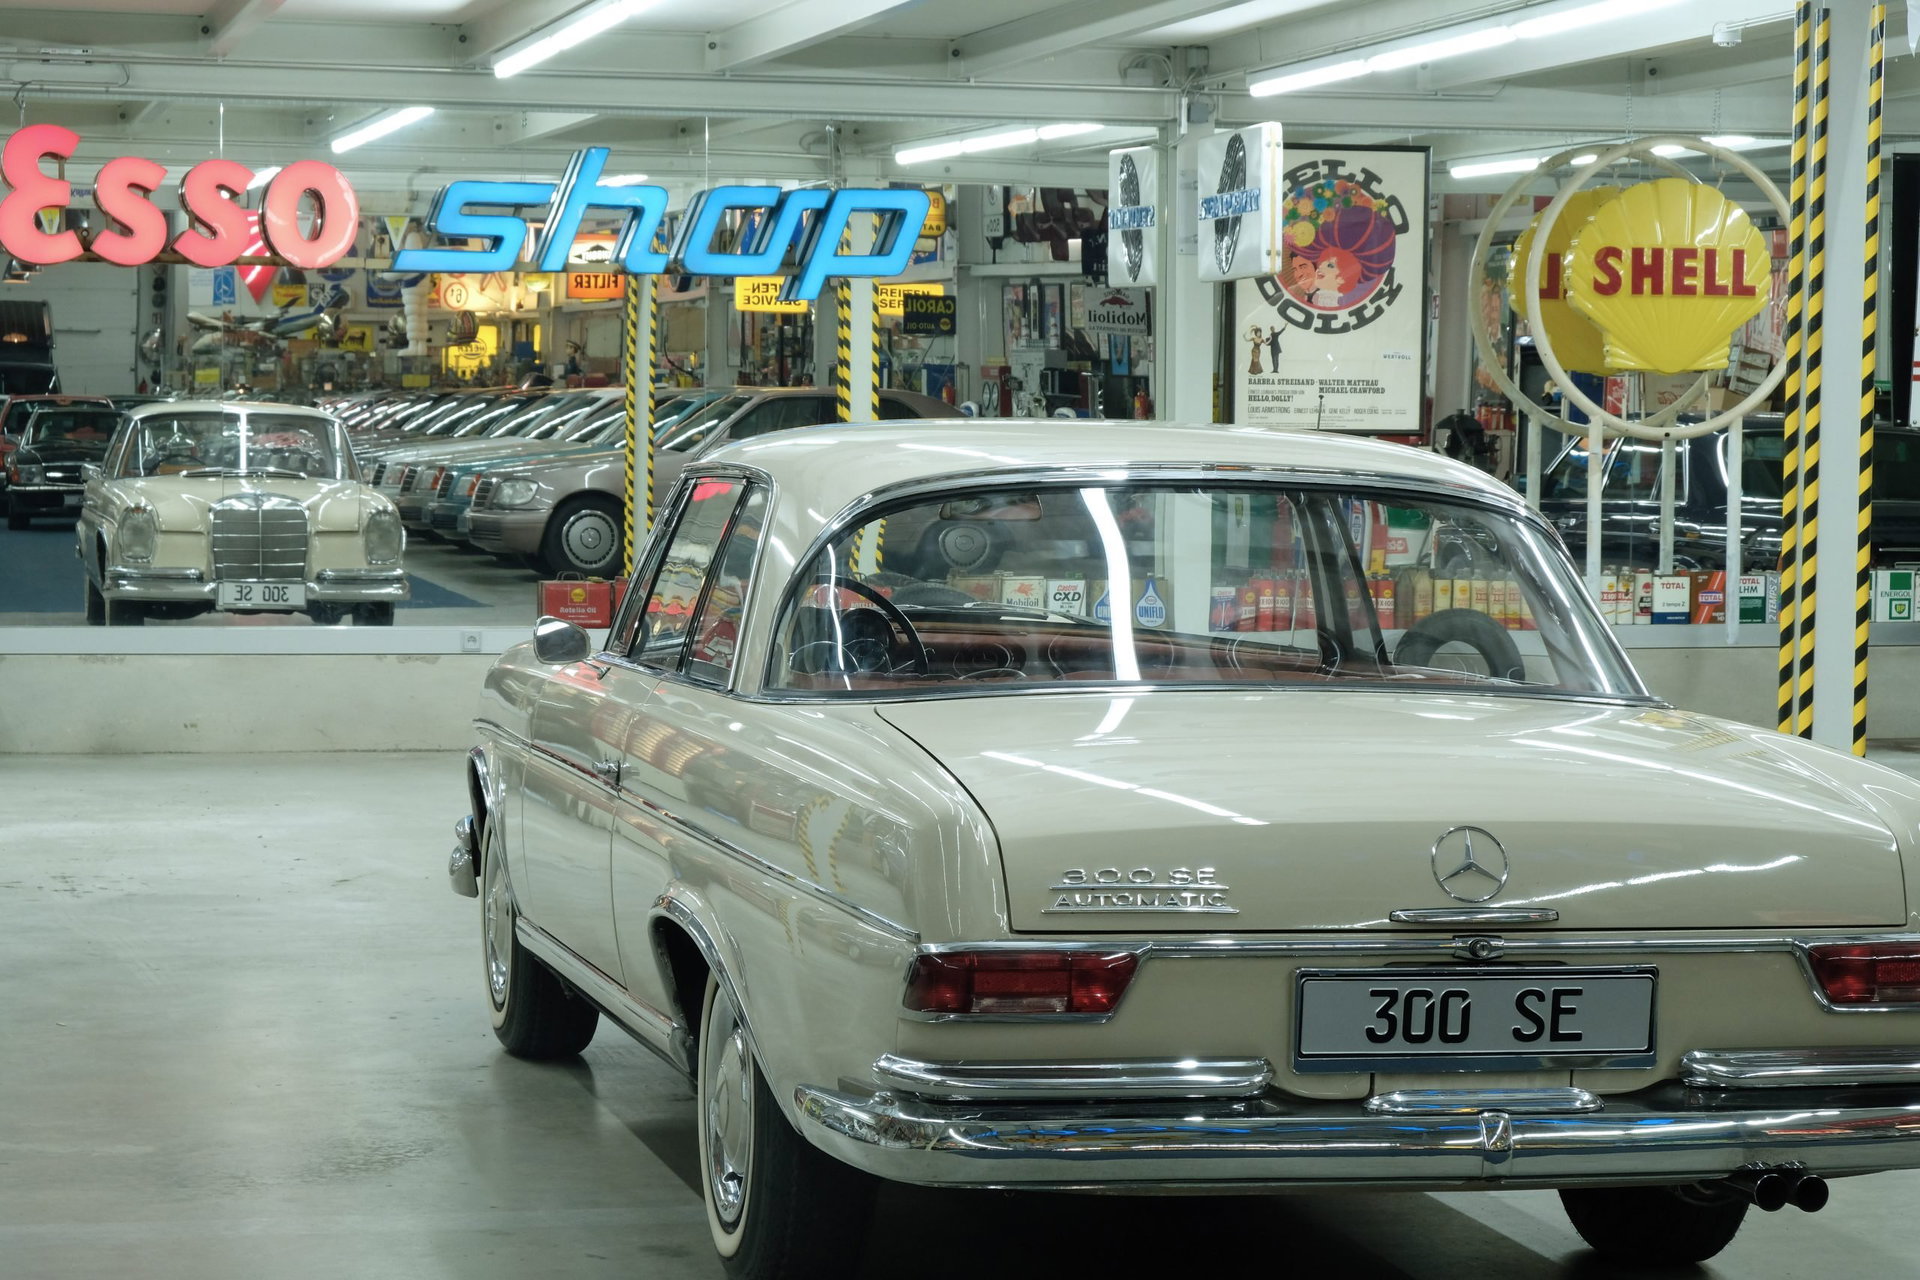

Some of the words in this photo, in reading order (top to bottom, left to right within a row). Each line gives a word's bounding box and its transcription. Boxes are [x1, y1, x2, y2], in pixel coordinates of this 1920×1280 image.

[1283, 159, 1410, 235] ELLO
[396, 147, 931, 300] shop
[1593, 246, 1757, 297] SHELL
[1255, 267, 1403, 335] DOLLY
[1277, 378, 1315, 386] STREISAND
[1248, 395, 1270, 403] HELLO,
[1006, 598, 1039, 608] Mobiloil
[1053, 592, 1082, 602] CXD
[1701, 593, 1723, 601] TOTAL
[1769, 584, 1778, 613] TEMPS
[1138, 607, 1164, 618] UNIFLO
[1063, 868, 1155, 884] 300
[1169, 867, 1216, 884] SE
[1053, 893, 1226, 908] AUTOMATIC
[1365, 988, 1471, 1044] 300
[1512, 987, 1583, 1043] SE
